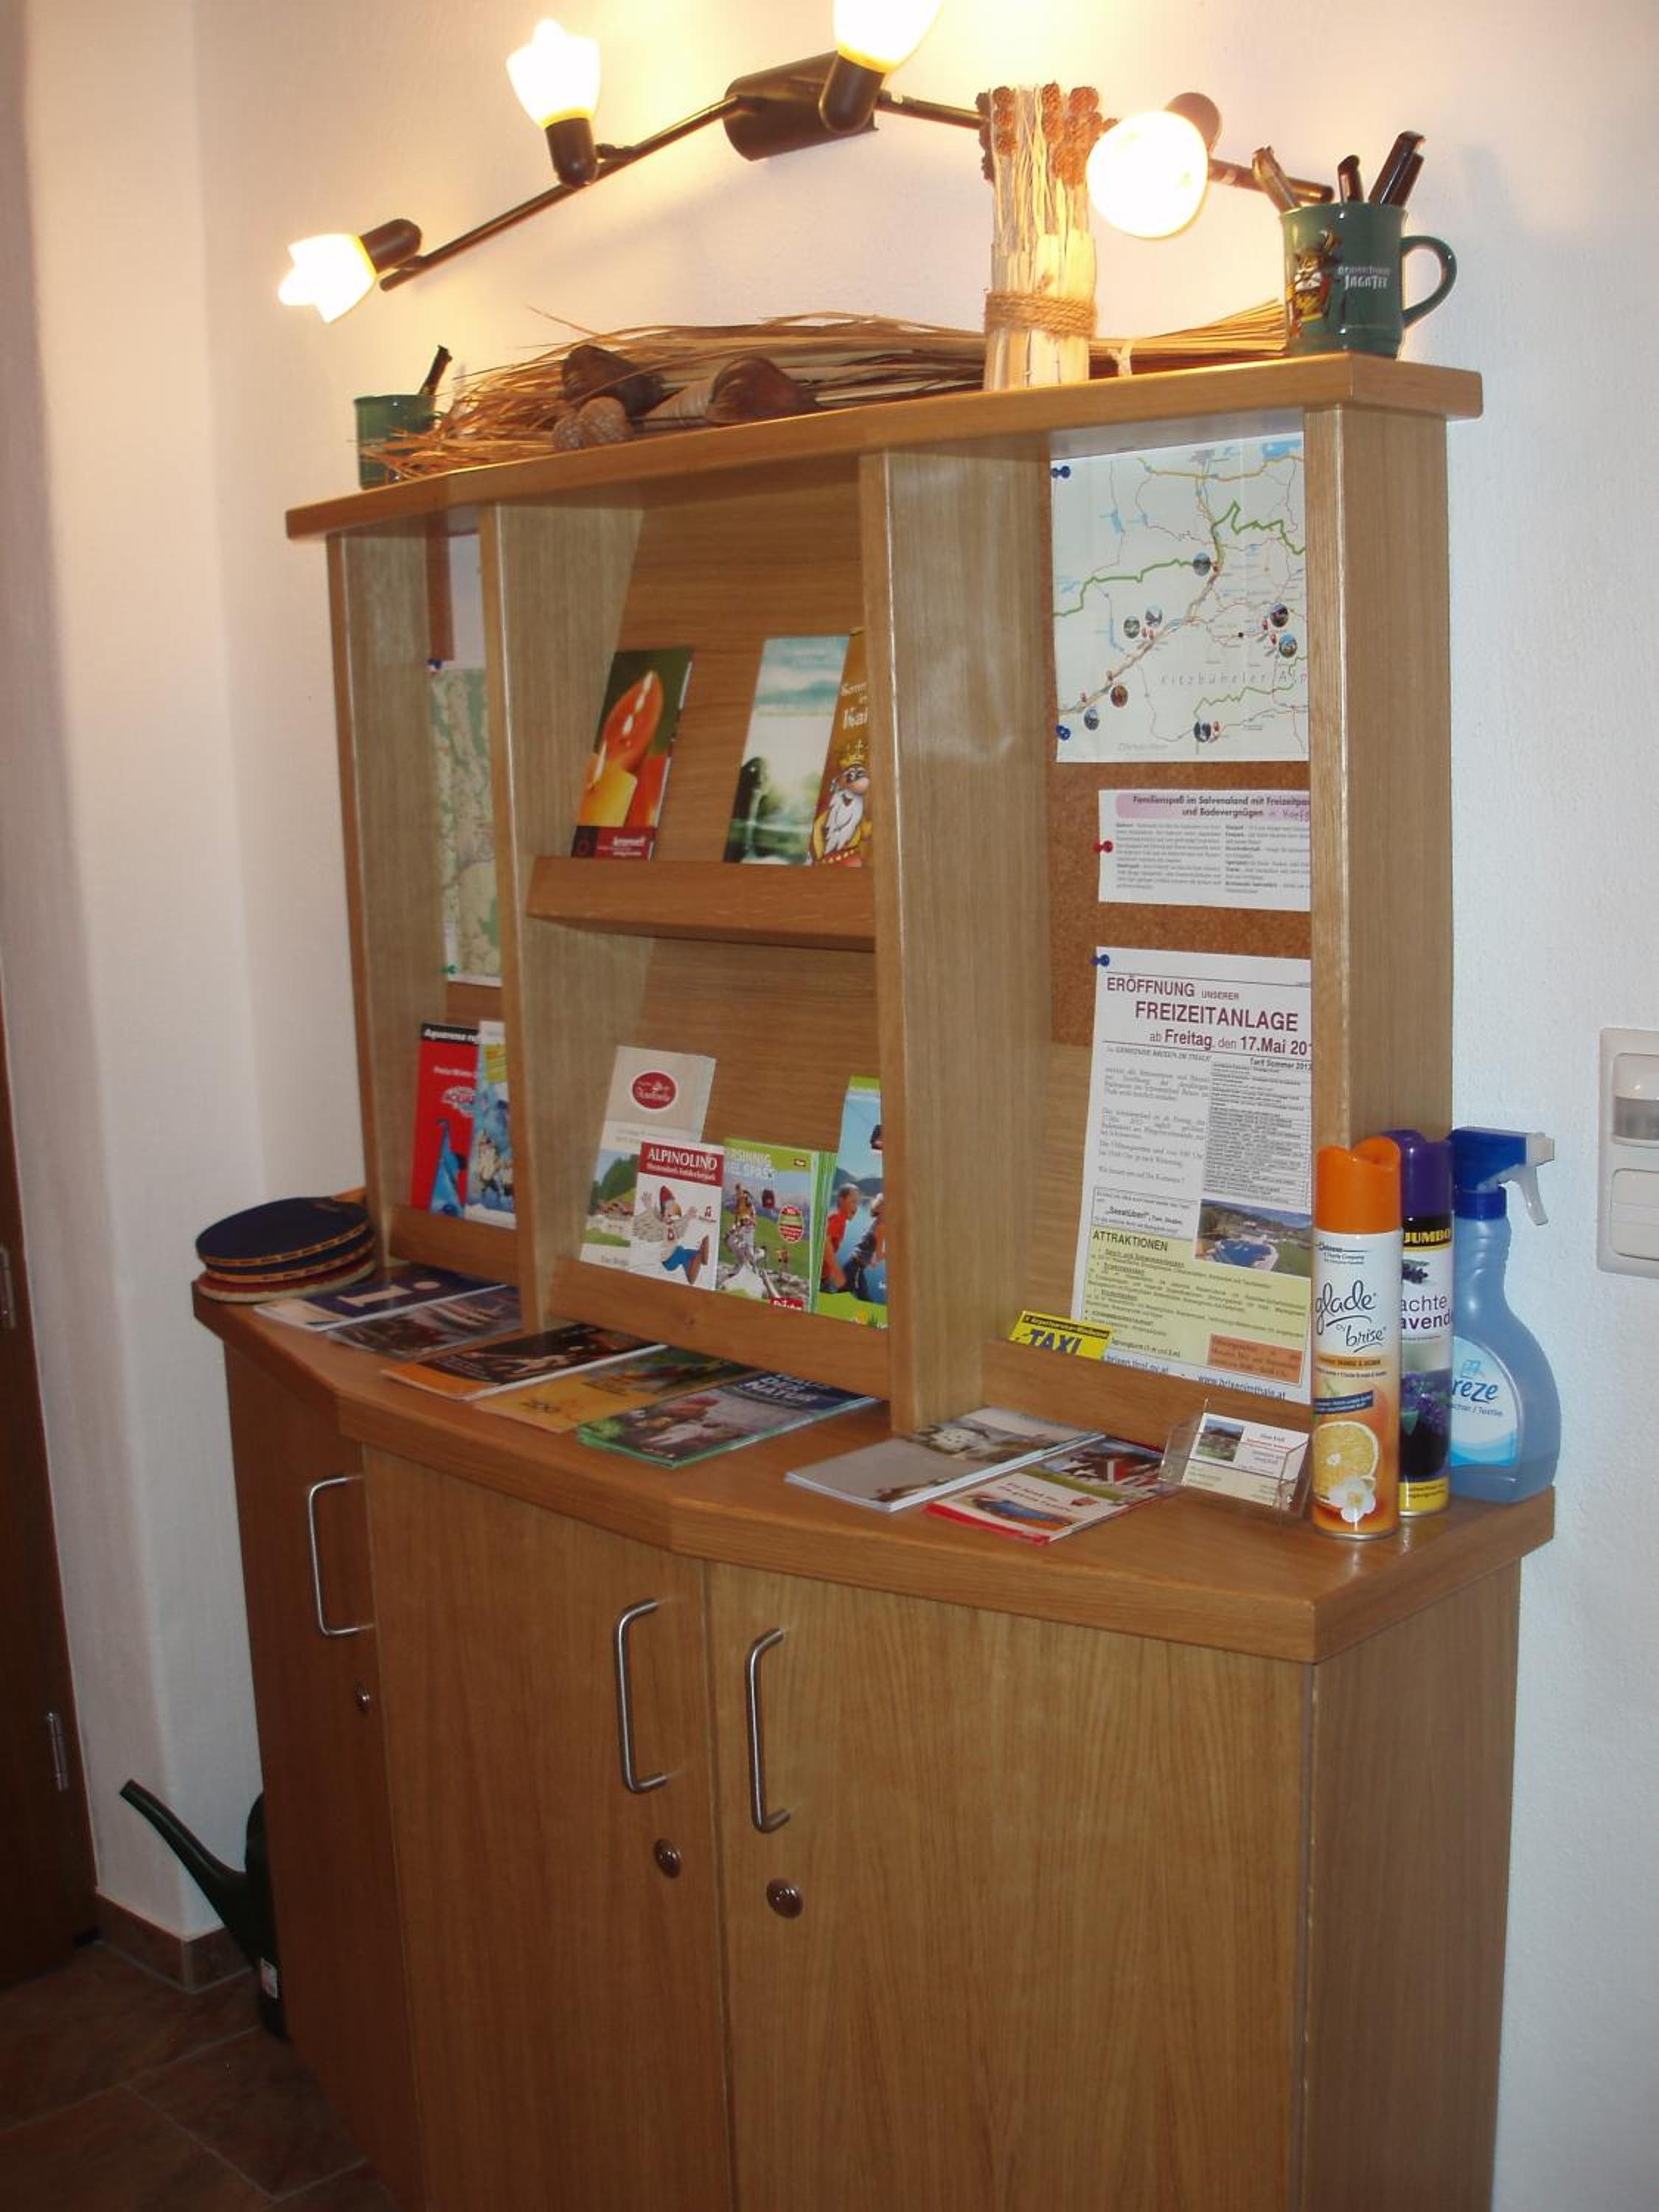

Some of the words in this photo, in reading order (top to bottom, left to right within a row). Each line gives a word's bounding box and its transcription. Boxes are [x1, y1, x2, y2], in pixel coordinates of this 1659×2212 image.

[1187, 796, 1197, 804] im
[1251, 796, 1265, 806] mit
[1182, 807, 1197, 816] und
[1200, 807, 1263, 820] Badevergnügen
[1107, 975, 1195, 997] ERÖFFNUNG
[1201, 990, 1239, 1001] UNSERER
[1135, 1001, 1298, 1032] FREIZEITANLAGE
[1150, 1032, 1161, 1043] ab
[1217, 1037, 1237, 1049] den
[1240, 1035, 1286, 1054] 17.Mai
[1266, 1059, 1294, 1069] Sommer
[649, 1147, 718, 1172] ALPINOLINO
[1093, 1230, 1169, 1251] ATTRAKTIONEN
[1404, 1228, 1451, 1244] JUMBO
[1315, 1280, 1376, 1335] glade
[1030, 1329, 1083, 1356] TAXI
[1346, 1325, 1384, 1347] brise
